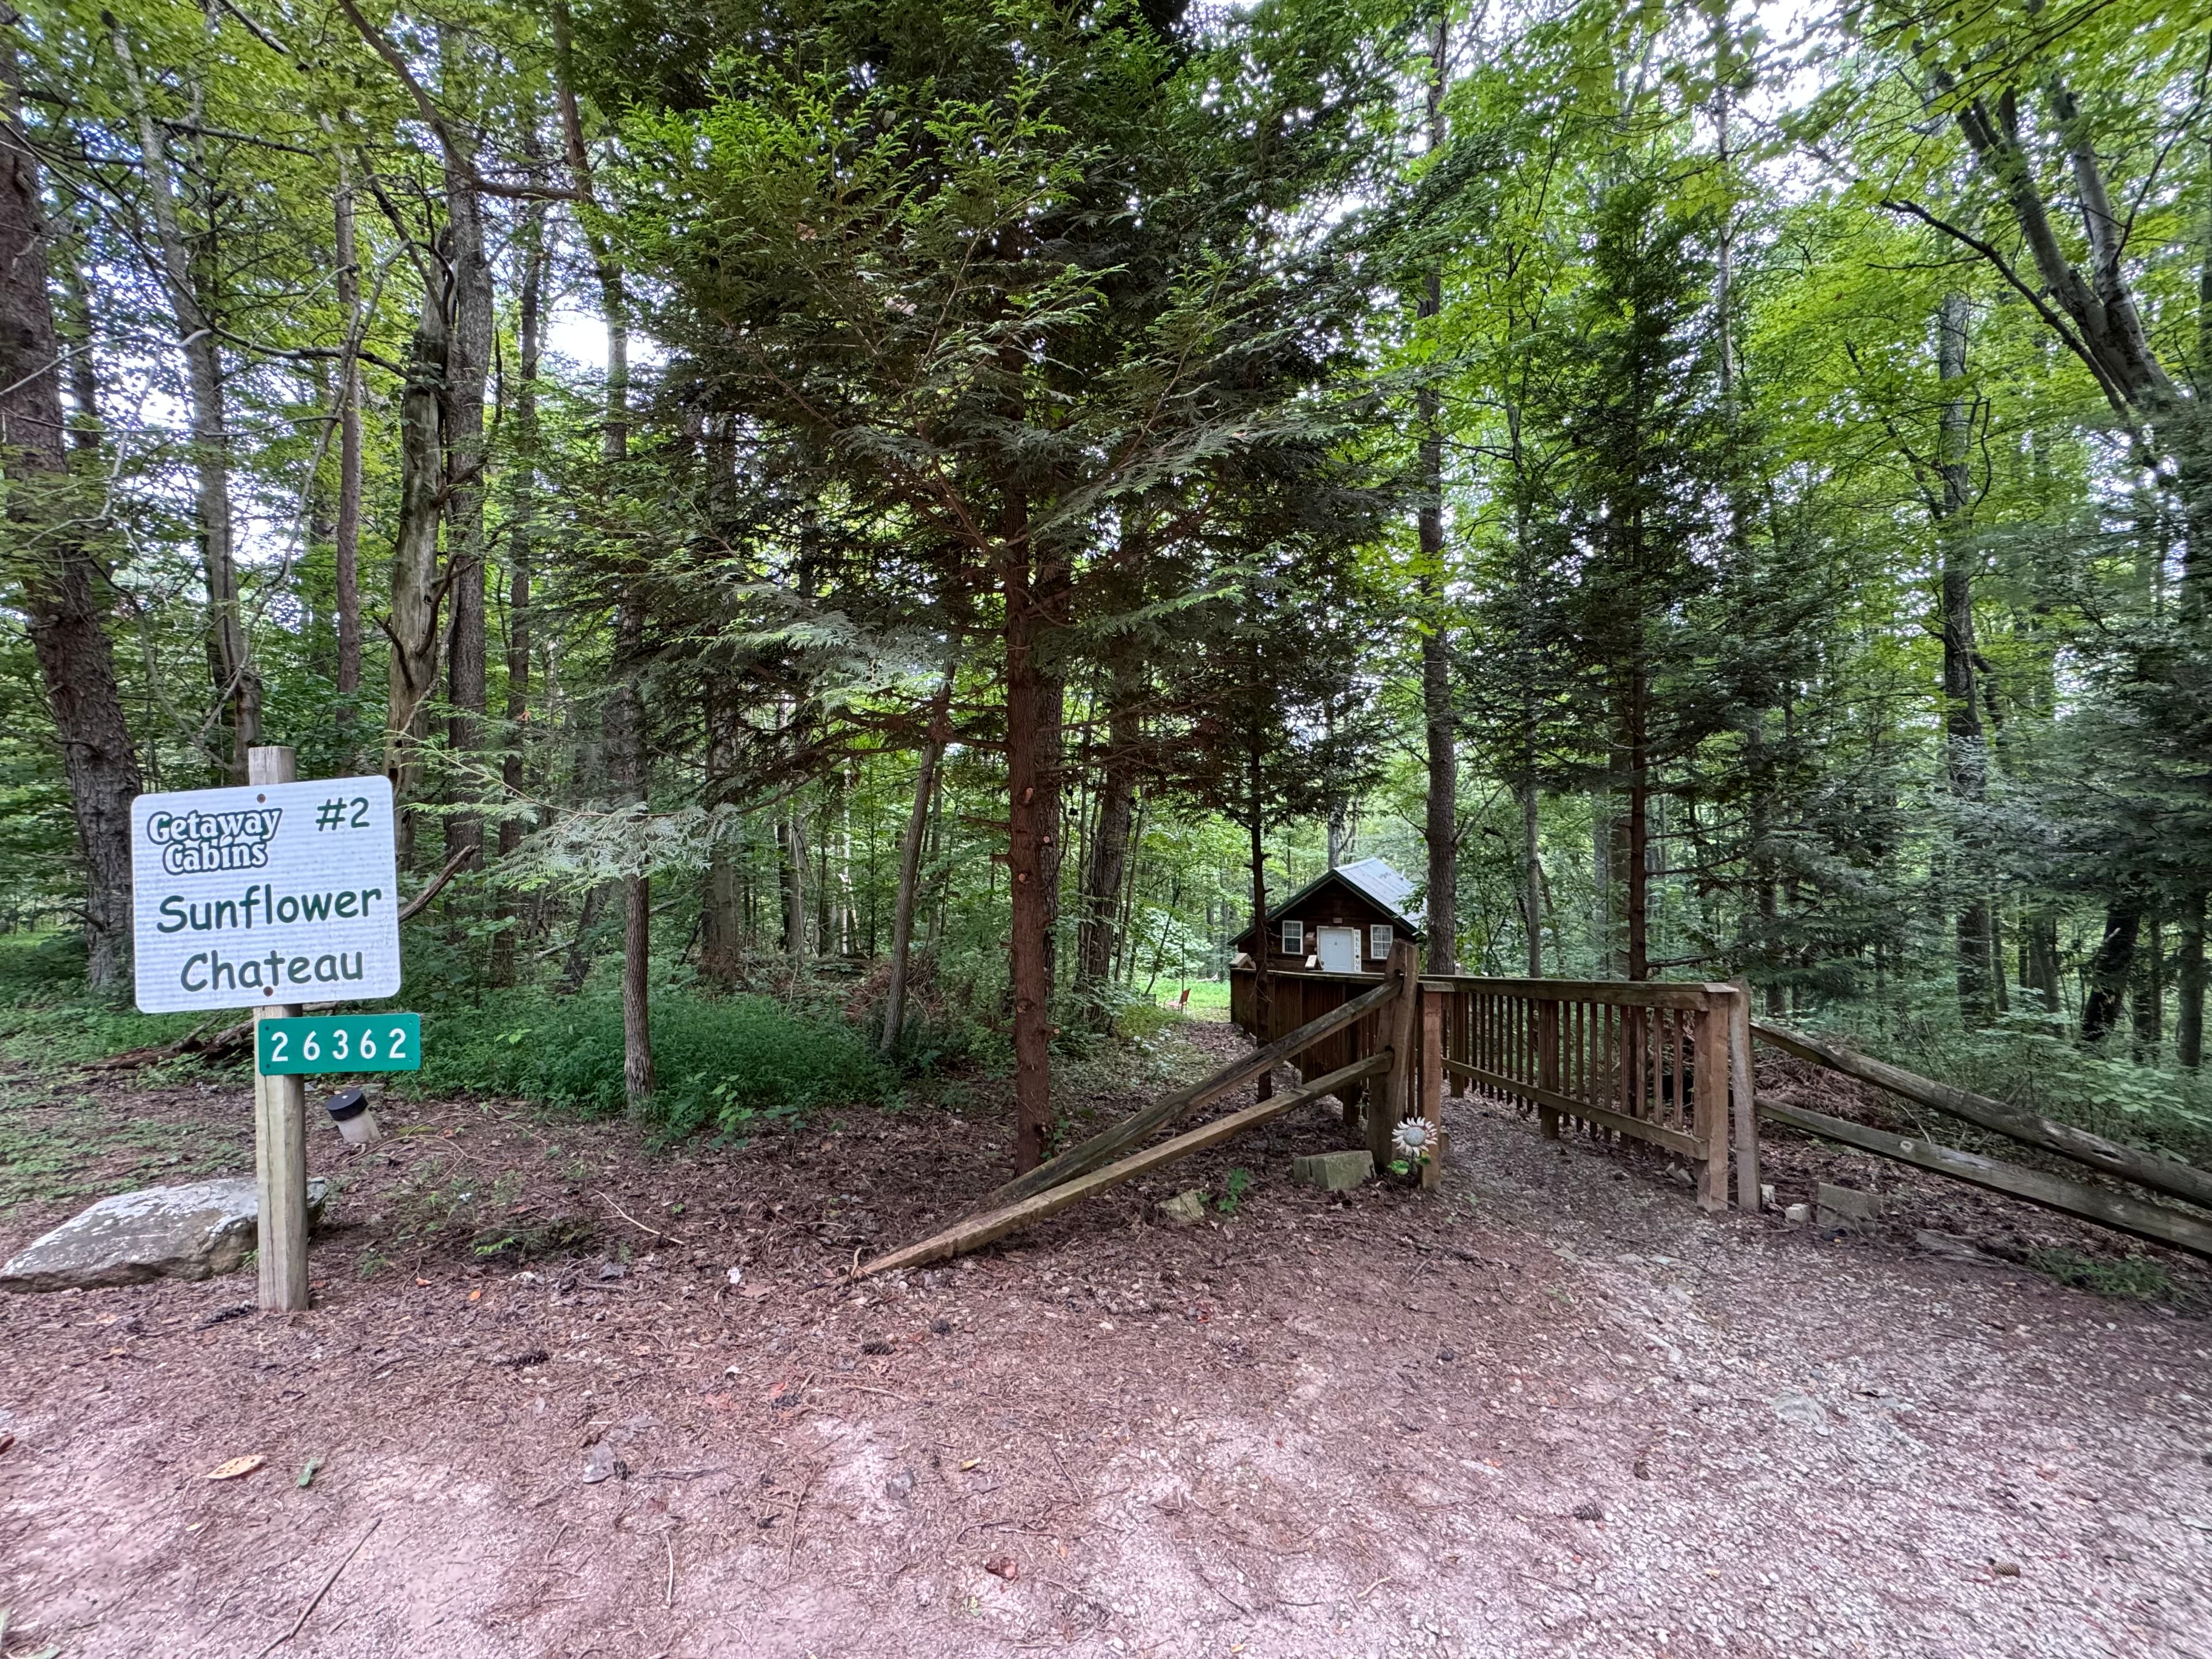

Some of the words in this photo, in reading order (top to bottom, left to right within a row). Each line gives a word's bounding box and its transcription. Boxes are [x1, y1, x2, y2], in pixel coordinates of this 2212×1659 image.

[147, 808, 283, 845] Getaway
[316, 797, 370, 831] #2
[162, 836, 268, 876] Cabins
[157, 884, 382, 933] Sunflower
[180, 950, 363, 992] Chateau
[271, 1028, 406, 1062] 26362
